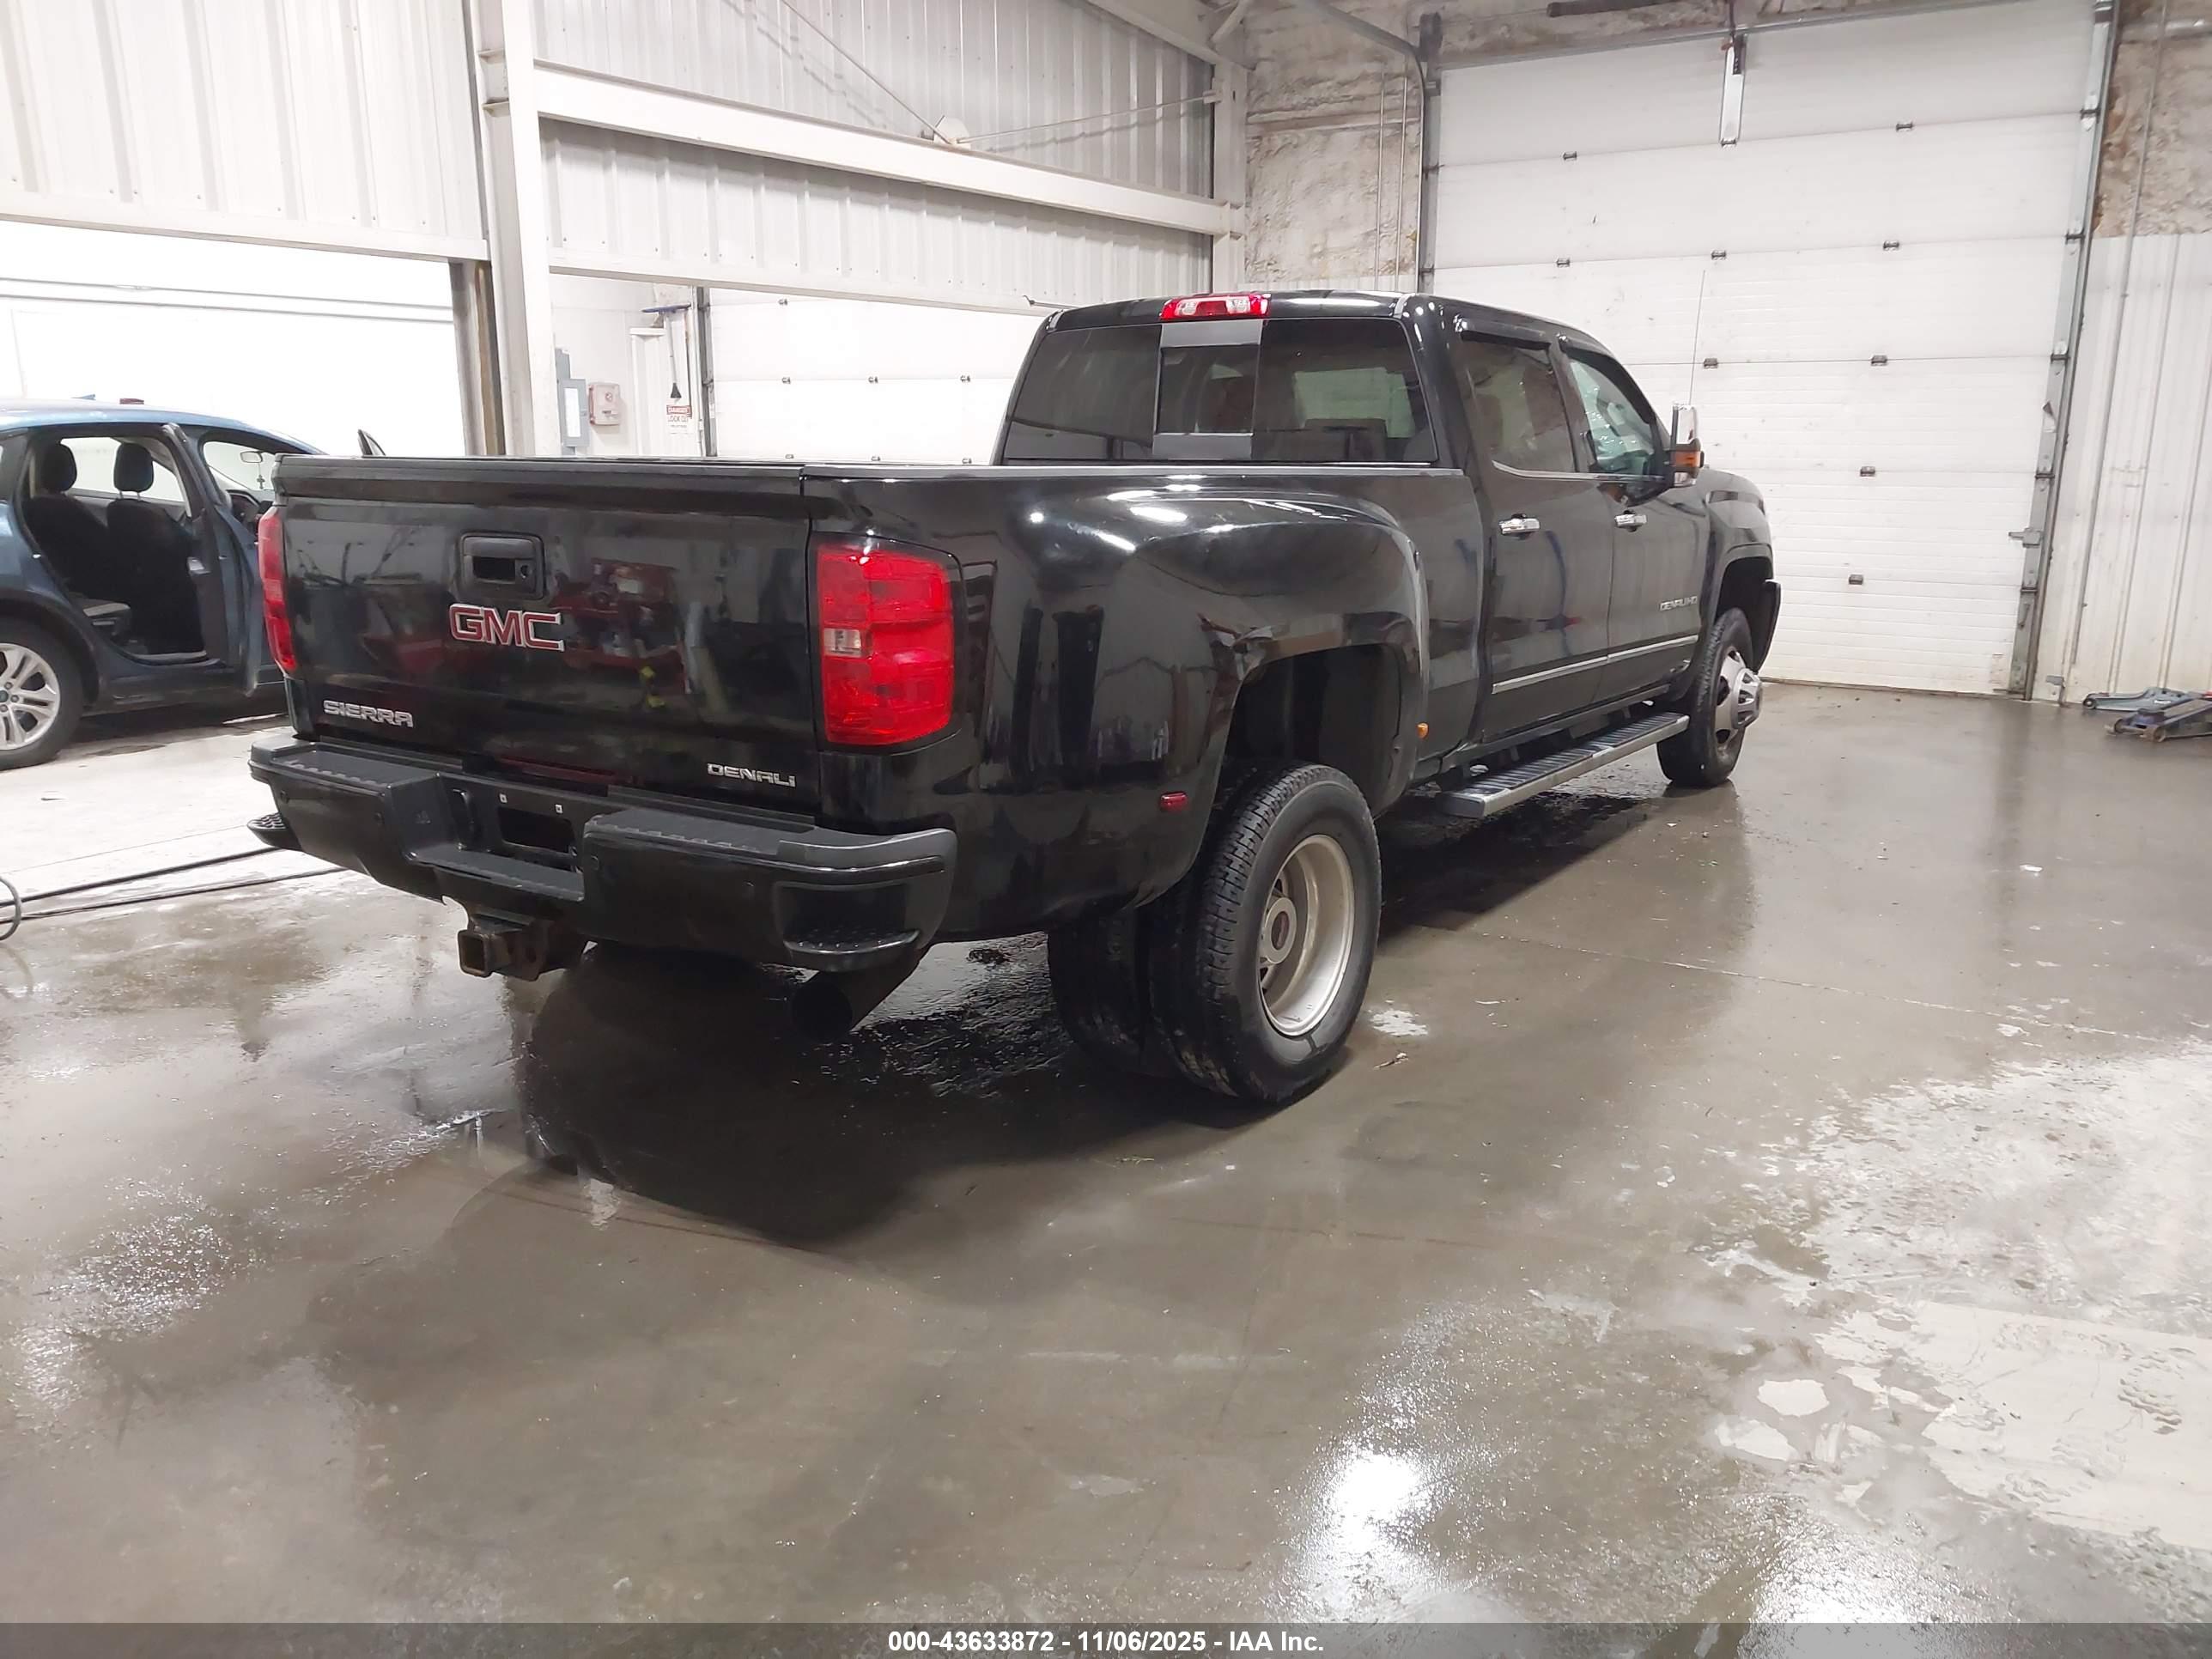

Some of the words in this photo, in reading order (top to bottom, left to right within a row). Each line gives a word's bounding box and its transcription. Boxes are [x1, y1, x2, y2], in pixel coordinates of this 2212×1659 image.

[448, 604, 564, 651] GMC
[323, 701, 414, 728] SIERRA
[707, 763, 797, 787] DENALI
